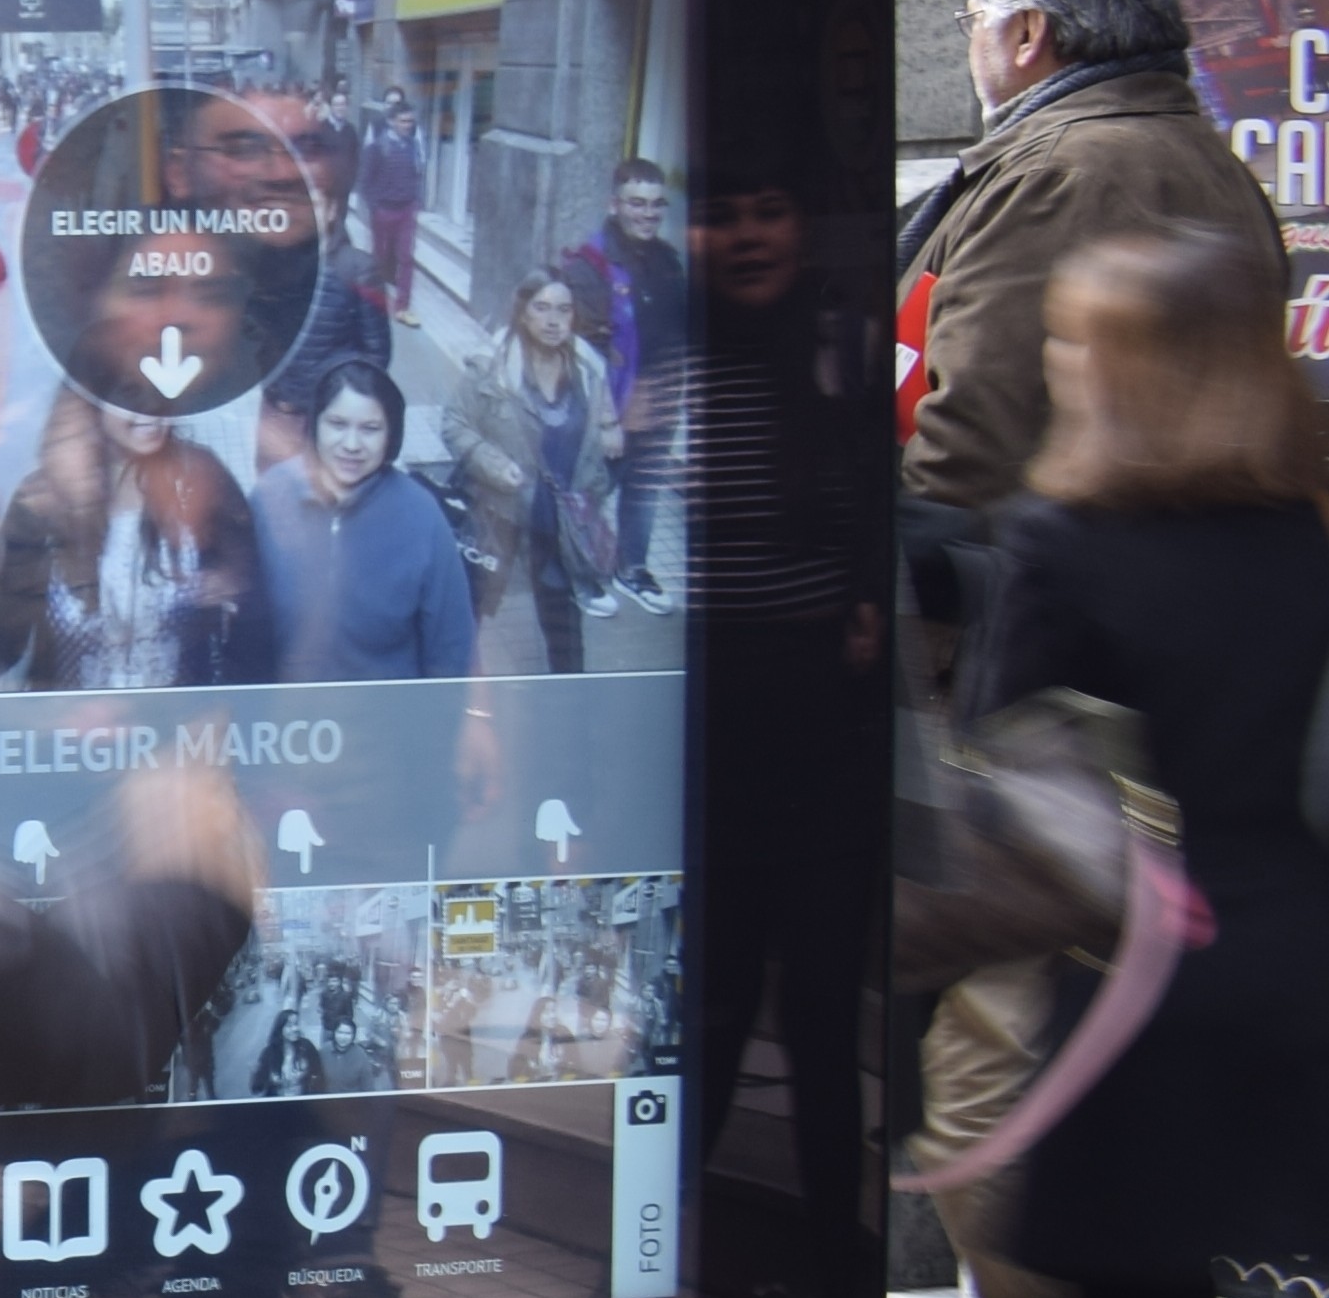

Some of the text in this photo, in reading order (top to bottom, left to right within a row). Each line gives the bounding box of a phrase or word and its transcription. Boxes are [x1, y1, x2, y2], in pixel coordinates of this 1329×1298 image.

[51, 208, 290, 236] ELEGIR UN MARCO
[128, 251, 214, 278] ABAJO
[175, 719, 343, 769] MARCO
[638, 1203, 662, 1274] FOTO
[288, 1267, 366, 1287] BÚSQUEDA
[414, 1258, 504, 1277] TRANSPORTE
[161, 1276, 222, 1294] AGENDA
